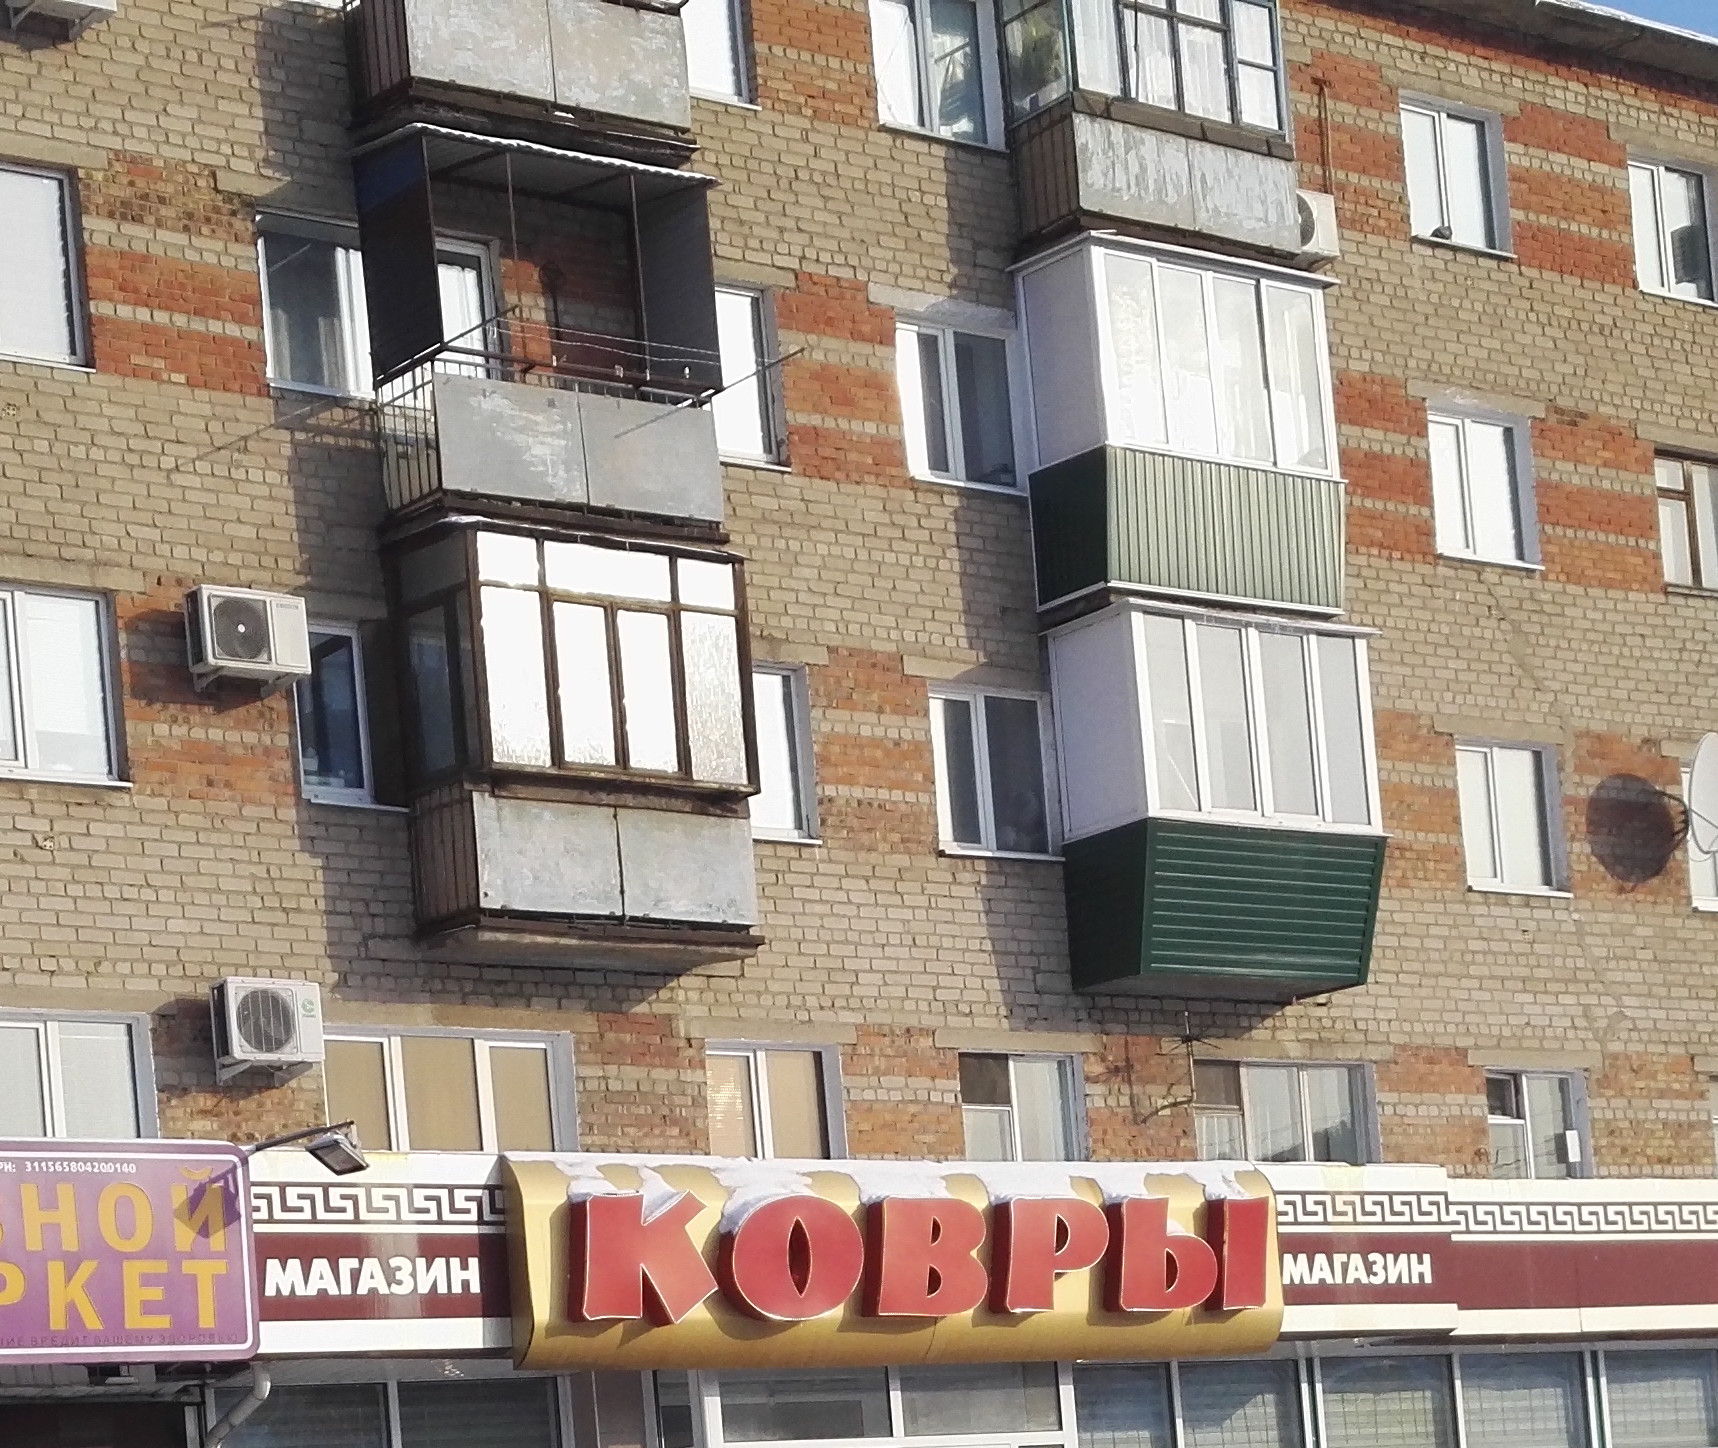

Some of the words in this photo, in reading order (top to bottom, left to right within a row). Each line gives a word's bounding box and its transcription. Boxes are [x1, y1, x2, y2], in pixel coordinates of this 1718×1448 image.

[264, 1256, 481, 1297] МАГАЗИН
[567, 1190, 1270, 1323] КОВРЫ
[1282, 1252, 1433, 1285] МАГАЗИН
